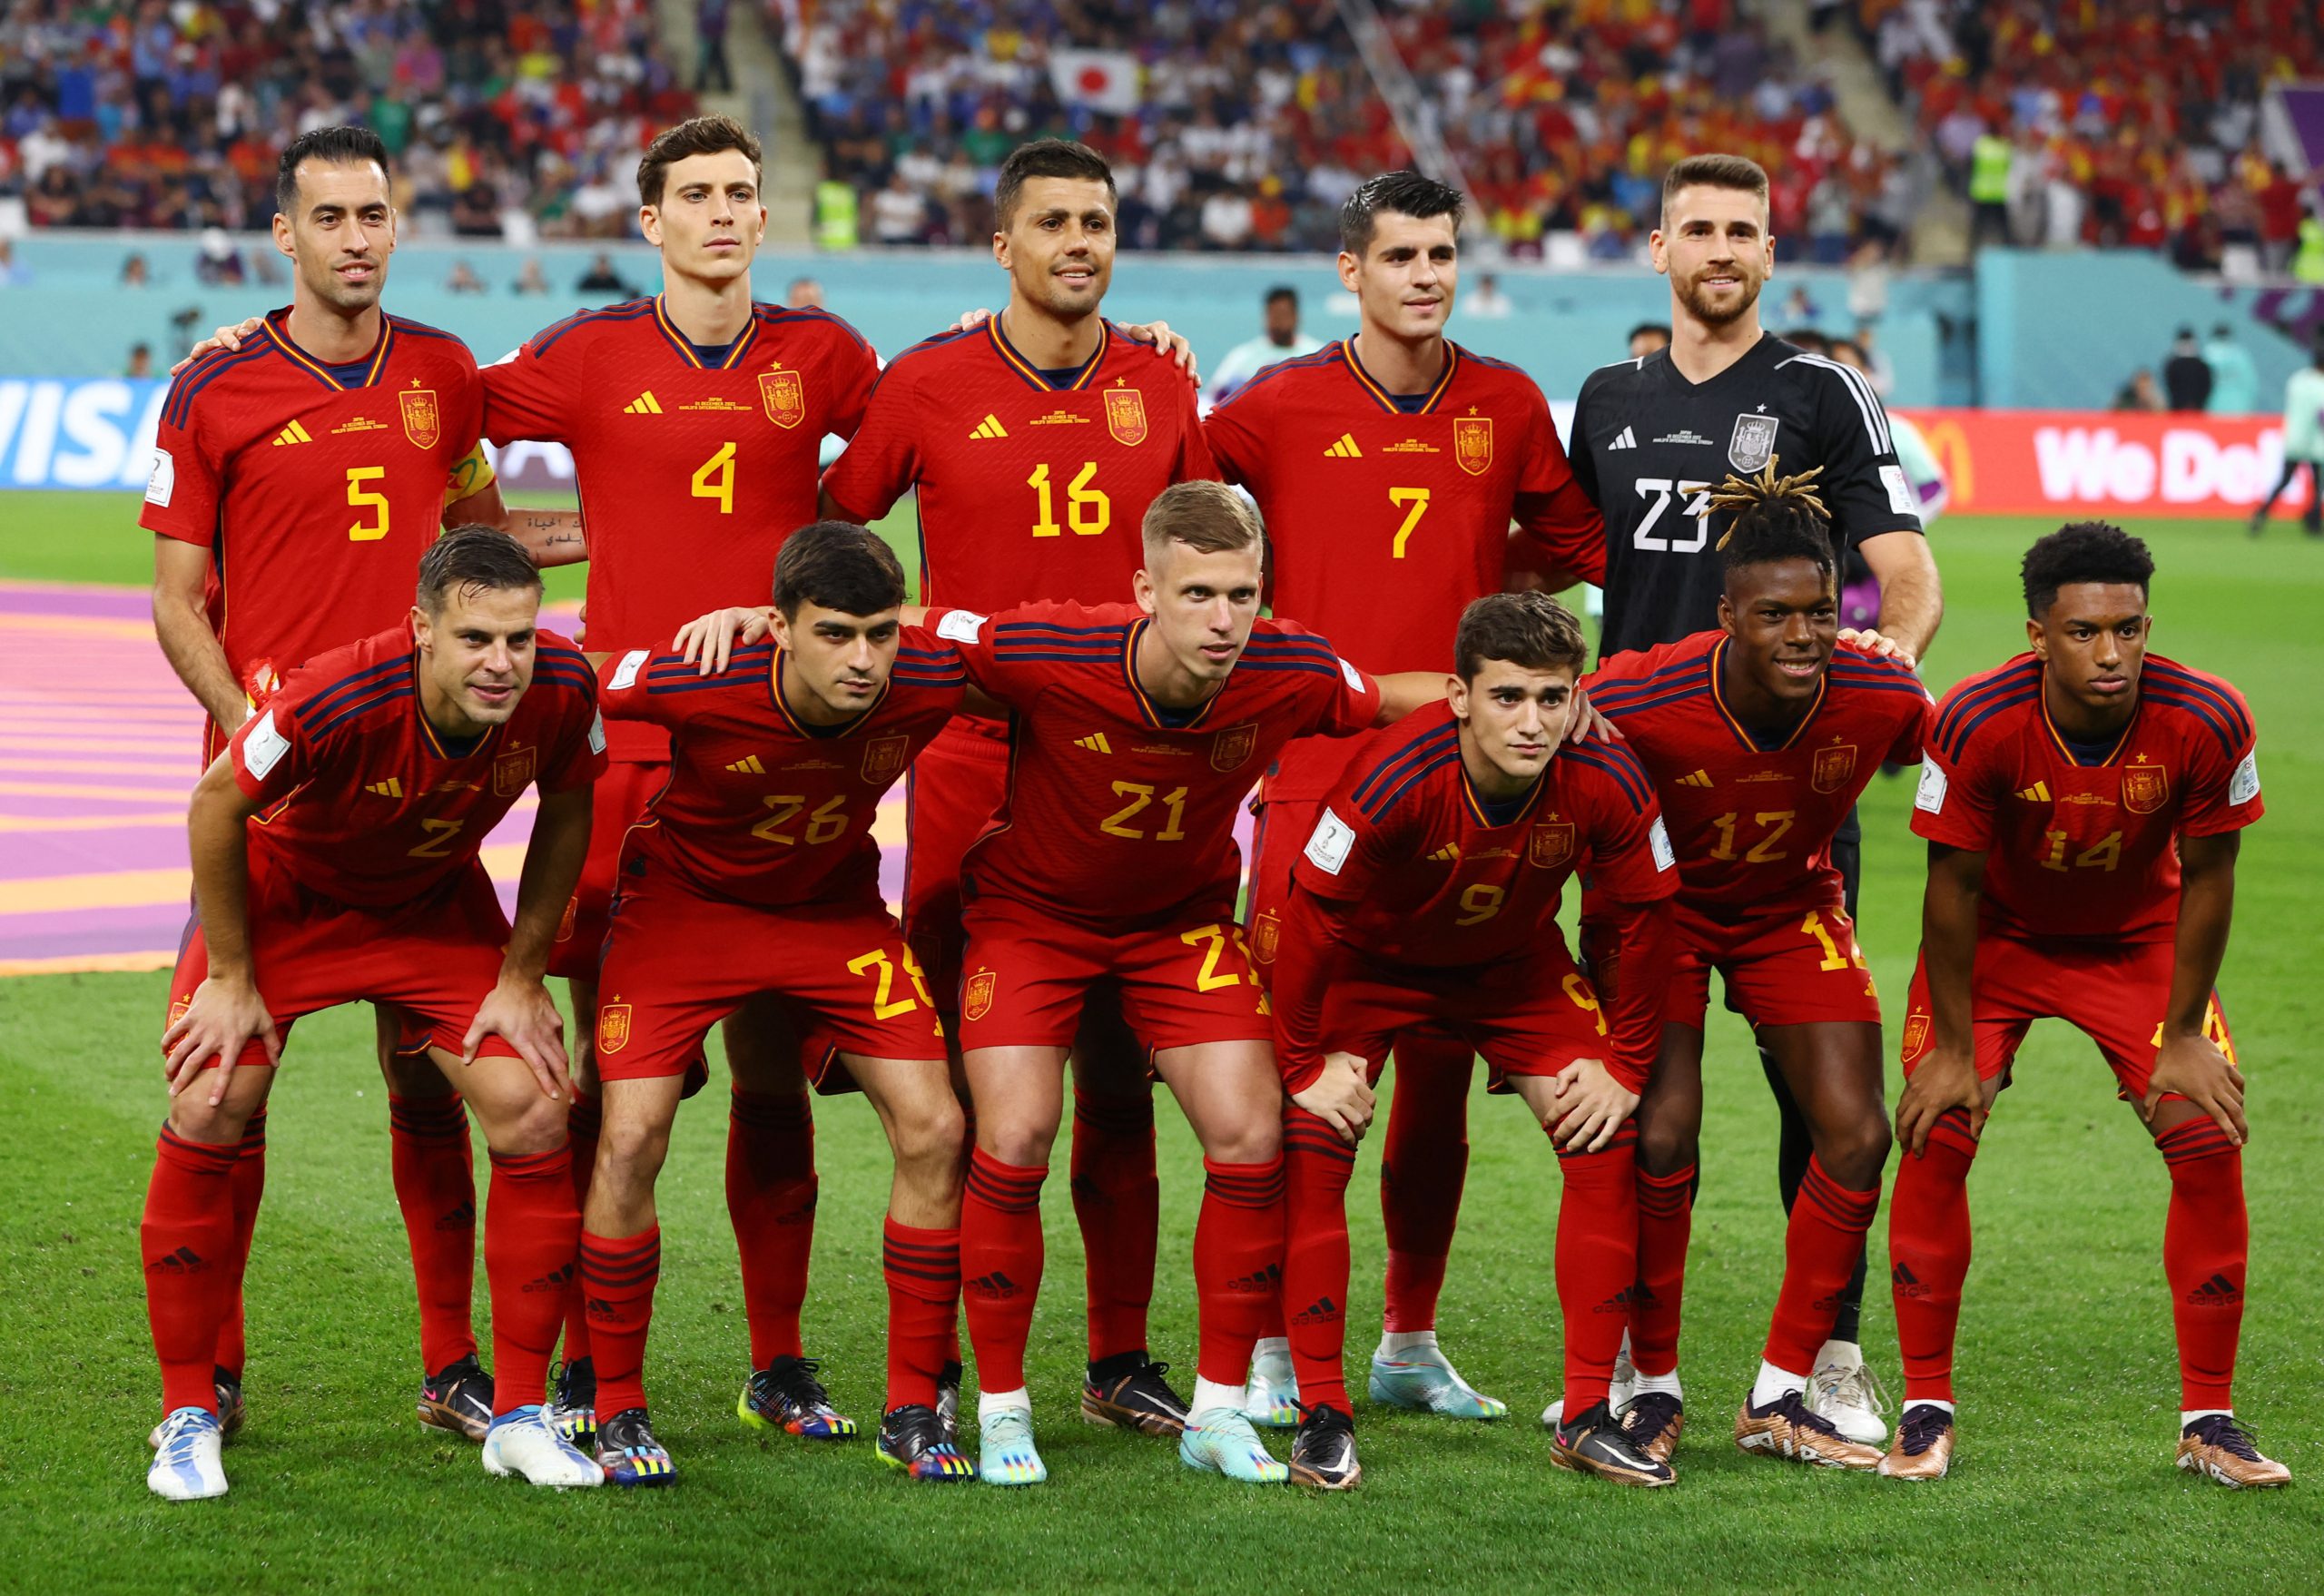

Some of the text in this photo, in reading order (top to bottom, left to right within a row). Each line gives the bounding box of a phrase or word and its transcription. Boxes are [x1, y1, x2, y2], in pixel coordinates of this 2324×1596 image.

[691, 441, 737, 515] 4
[2033, 426, 2156, 503] We
[346, 466, 390, 542] 5
[1026, 461, 1111, 537] 16
[1388, 487, 1430, 559] 7
[1633, 478, 1712, 553] 23
[407, 817, 465, 858] 2
[751, 794, 847, 845] 26
[1098, 780, 1189, 842] 21
[1709, 810, 1797, 863] 12
[2040, 828, 2122, 872] 14
[1455, 883, 1505, 926] 9
[1562, 972, 1608, 1037] 9
